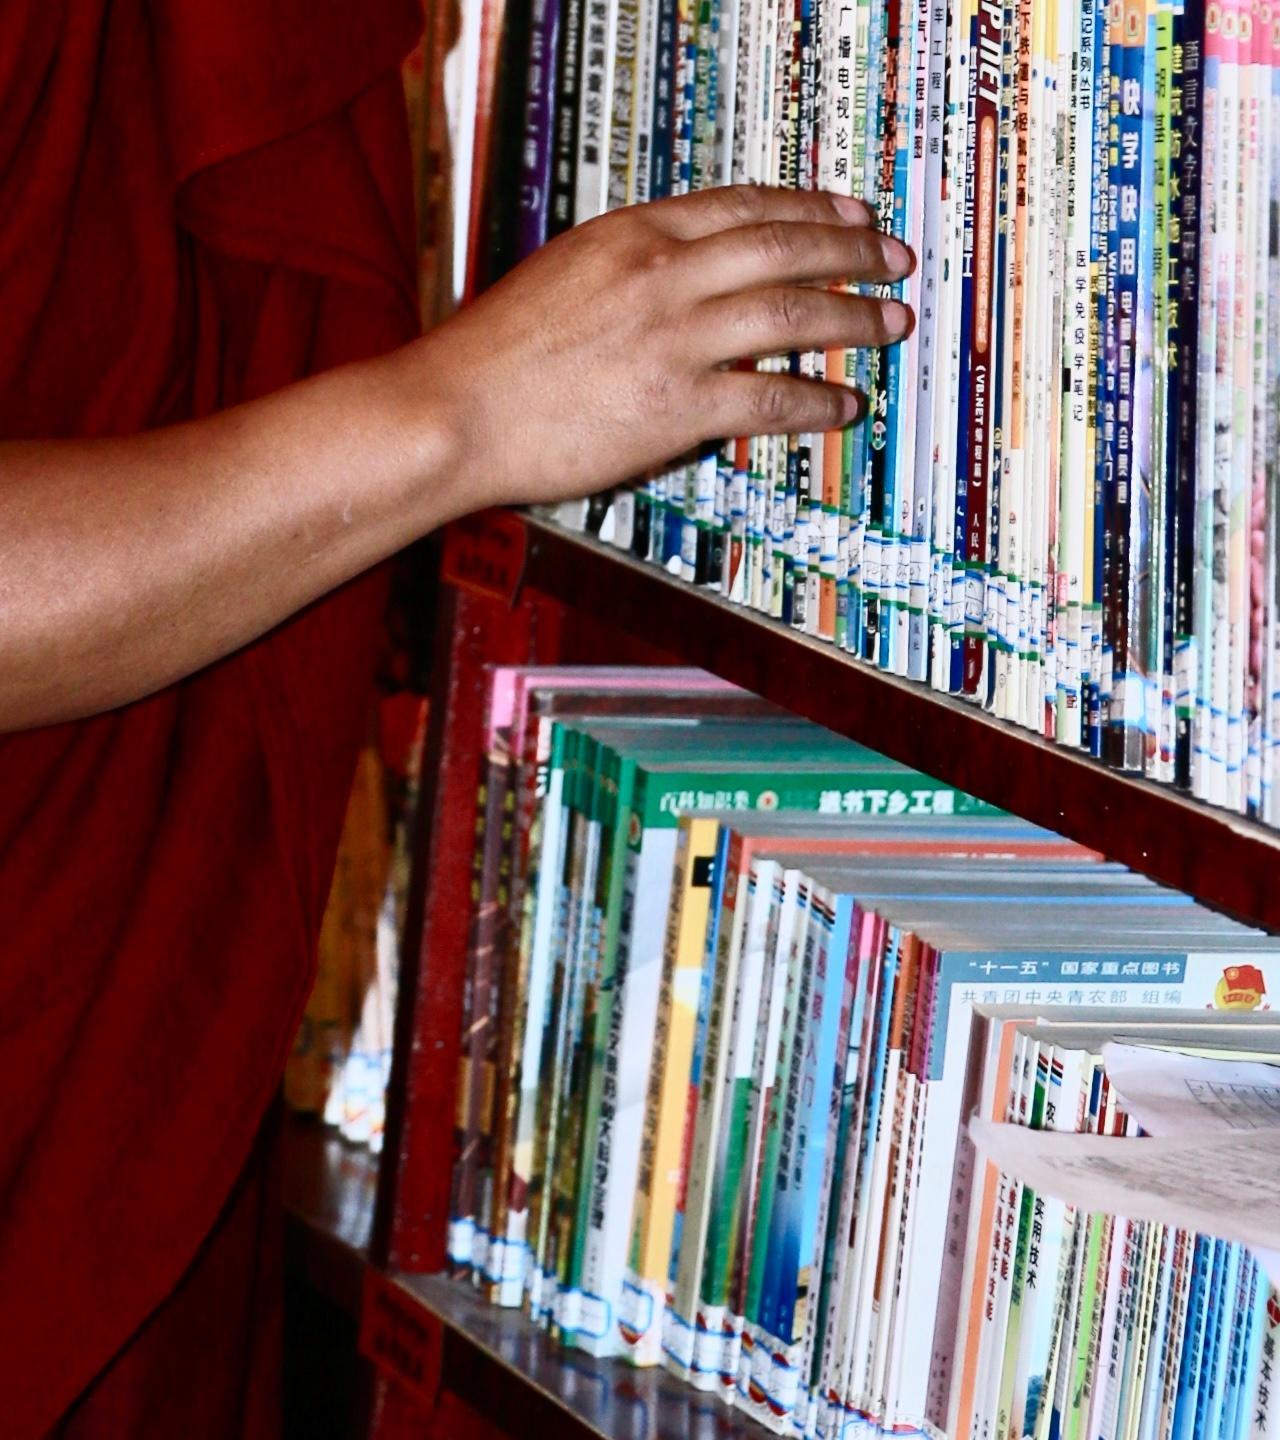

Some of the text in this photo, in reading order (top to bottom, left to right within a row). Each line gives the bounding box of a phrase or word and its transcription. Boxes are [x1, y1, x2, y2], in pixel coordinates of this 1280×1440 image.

[1119, 78, 1141, 276] 快学快用
[1167, 43, 1184, 369] 建筑防水施工技术
[1073, 250, 1087, 422] 医学免疫学笔记
[960, 988, 1183, 1006] 共青团中央青农部 组编
[1060, 960, 1181, 976] 国家重点图书
